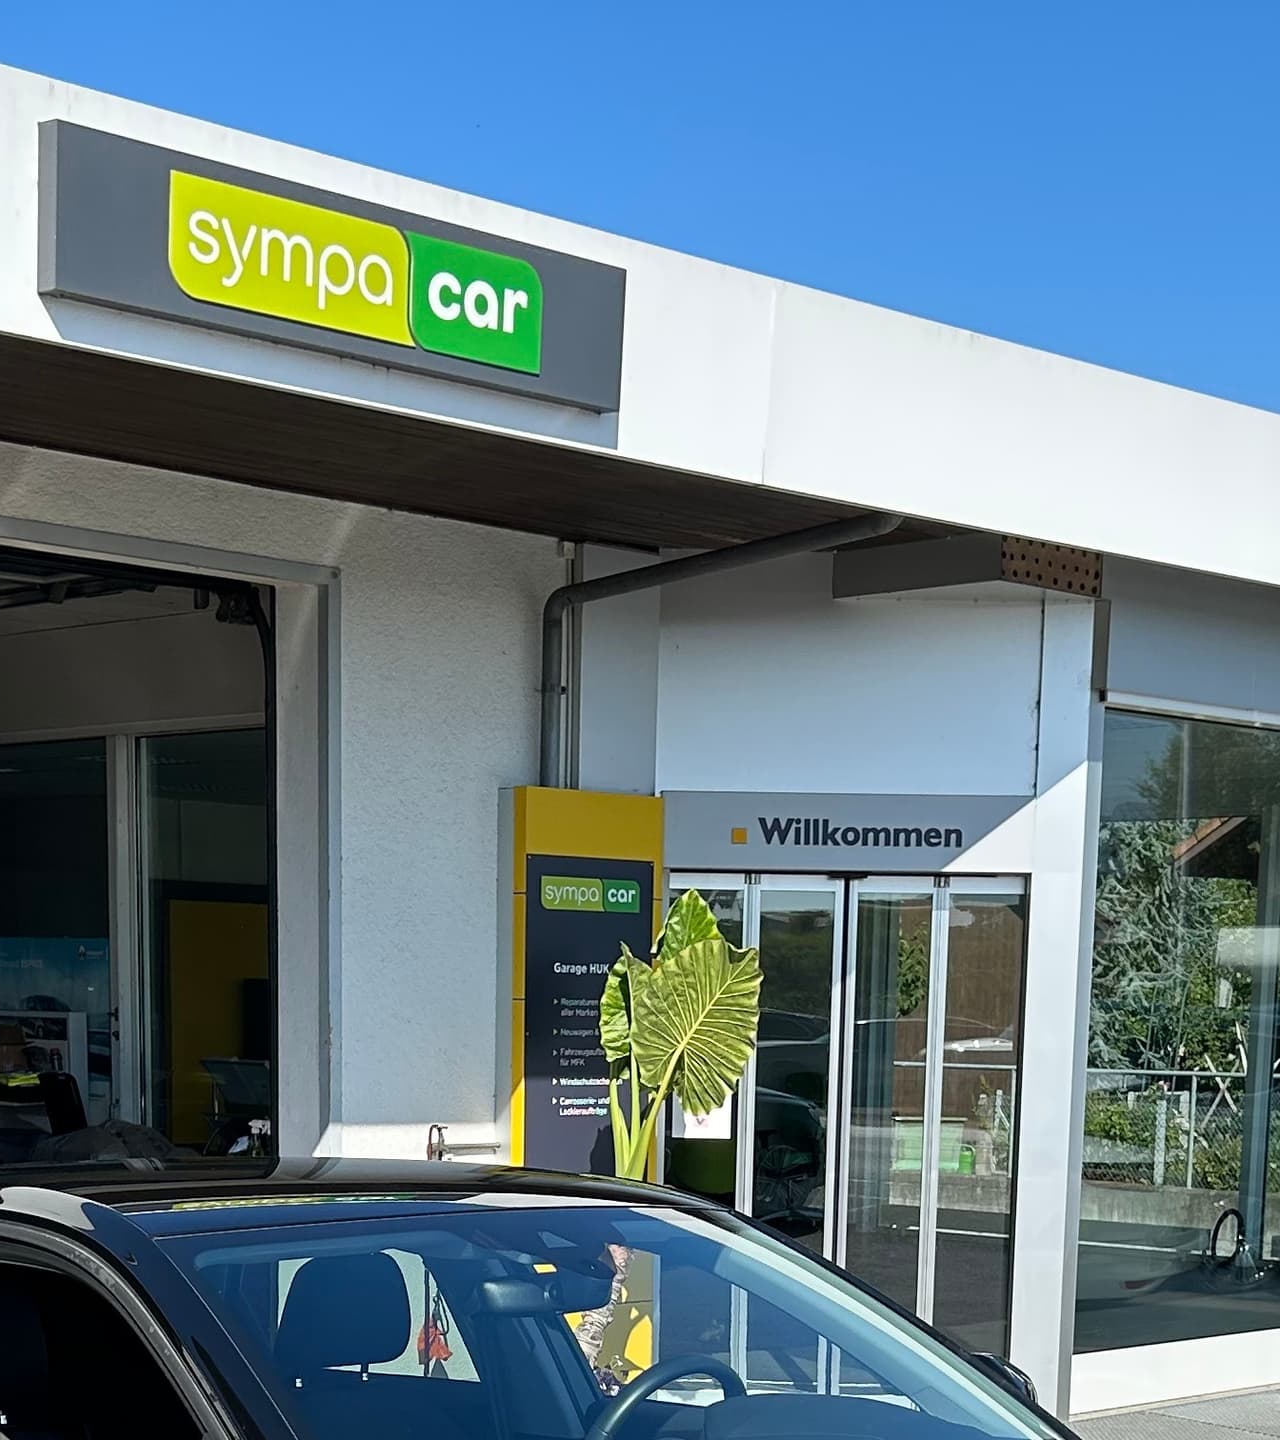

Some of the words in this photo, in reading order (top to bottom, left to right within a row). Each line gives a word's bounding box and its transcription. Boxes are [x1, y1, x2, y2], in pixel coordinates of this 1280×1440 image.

[186, 209, 394, 310] sympa
[427, 270, 529, 334] car
[758, 816, 963, 849] Willkommen
[545, 885, 600, 906] sympa
[607, 888, 637, 904] car
[554, 962, 587, 975] Garage
[589, 964, 609, 974] HUK
